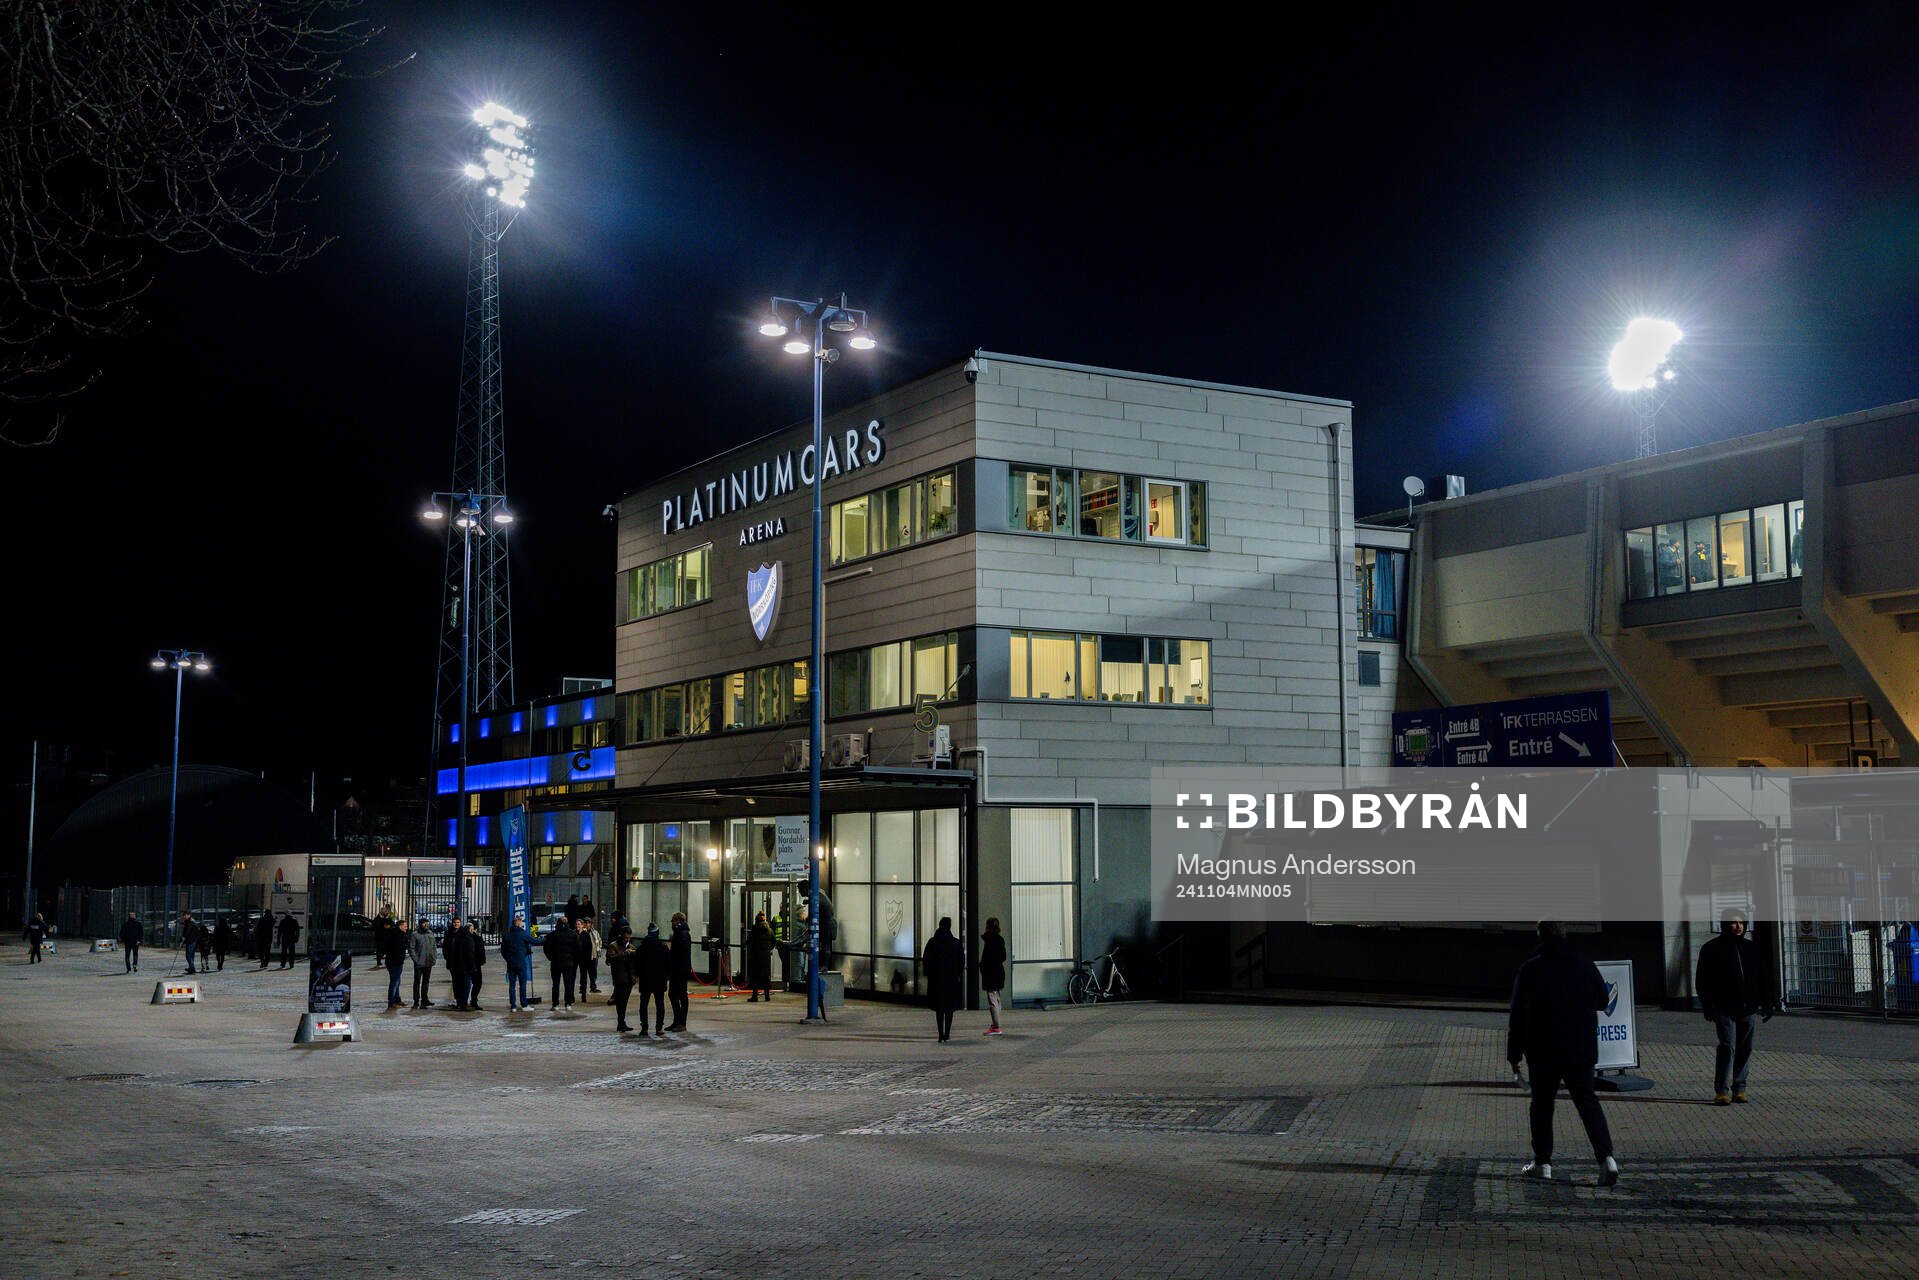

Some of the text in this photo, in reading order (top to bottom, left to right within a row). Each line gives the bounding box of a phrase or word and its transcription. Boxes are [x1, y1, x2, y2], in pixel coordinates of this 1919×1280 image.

[663, 420, 883, 534] PLATINUMCARS
[739, 517, 785, 546] ARENA
[750, 578, 763, 593] IFK
[914, 694, 941, 734] 5
[1503, 708, 1599, 729] IFKTERRASSEN
[1449, 718, 1480, 733] Entré 4B
[1509, 731, 1553, 757] Entré
[1457, 750, 1488, 765] Entré 4A
[778, 826, 801, 835] Gunnar
[778, 835, 806, 844] Nordahls
[778, 845, 793, 855] plats
